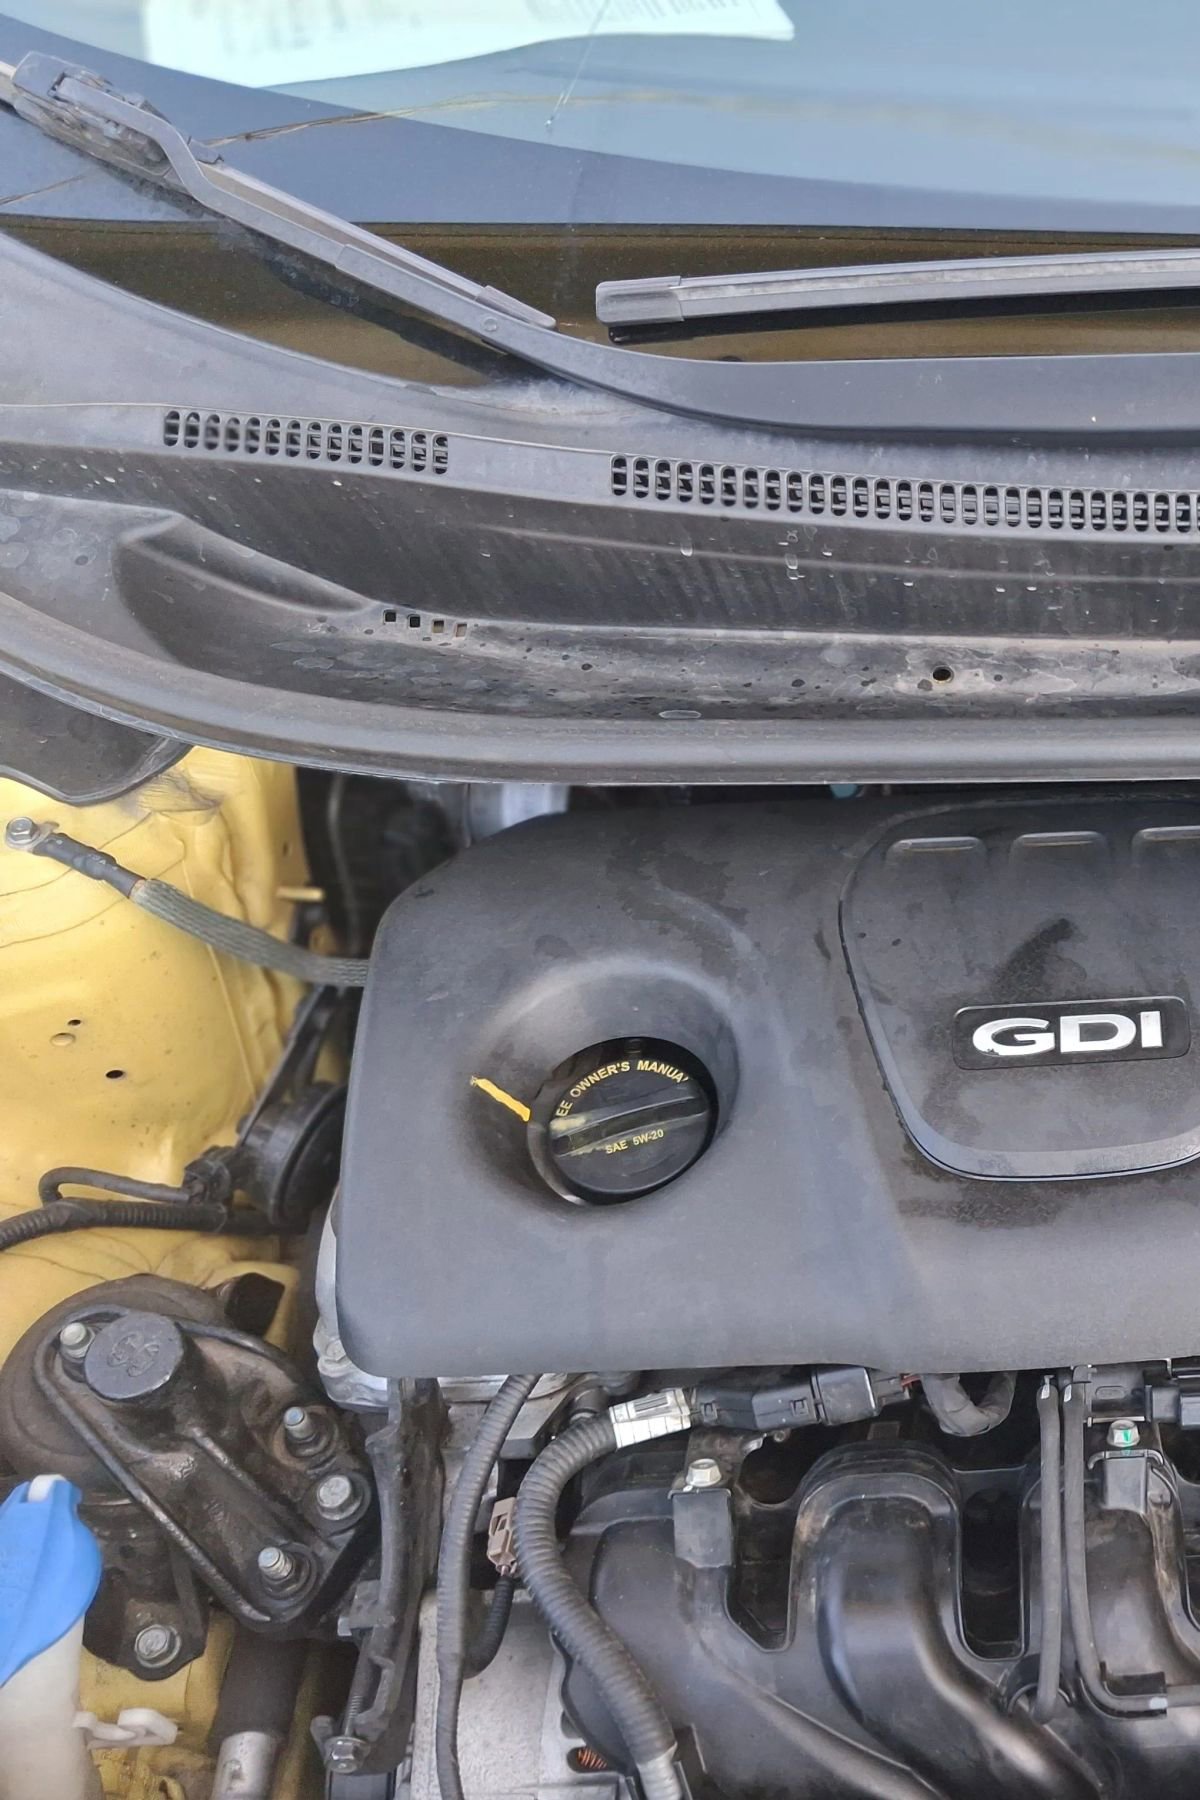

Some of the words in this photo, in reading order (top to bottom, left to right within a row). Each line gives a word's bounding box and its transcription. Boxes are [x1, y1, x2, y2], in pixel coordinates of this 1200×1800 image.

[972, 1010, 1163, 1057] GDI
[555, 1100, 573, 1117] EE
[570, 1061, 631, 1098] OWNER'S
[605, 1140, 629, 1154] SAE
[632, 1129, 664, 1146] 5W-20
